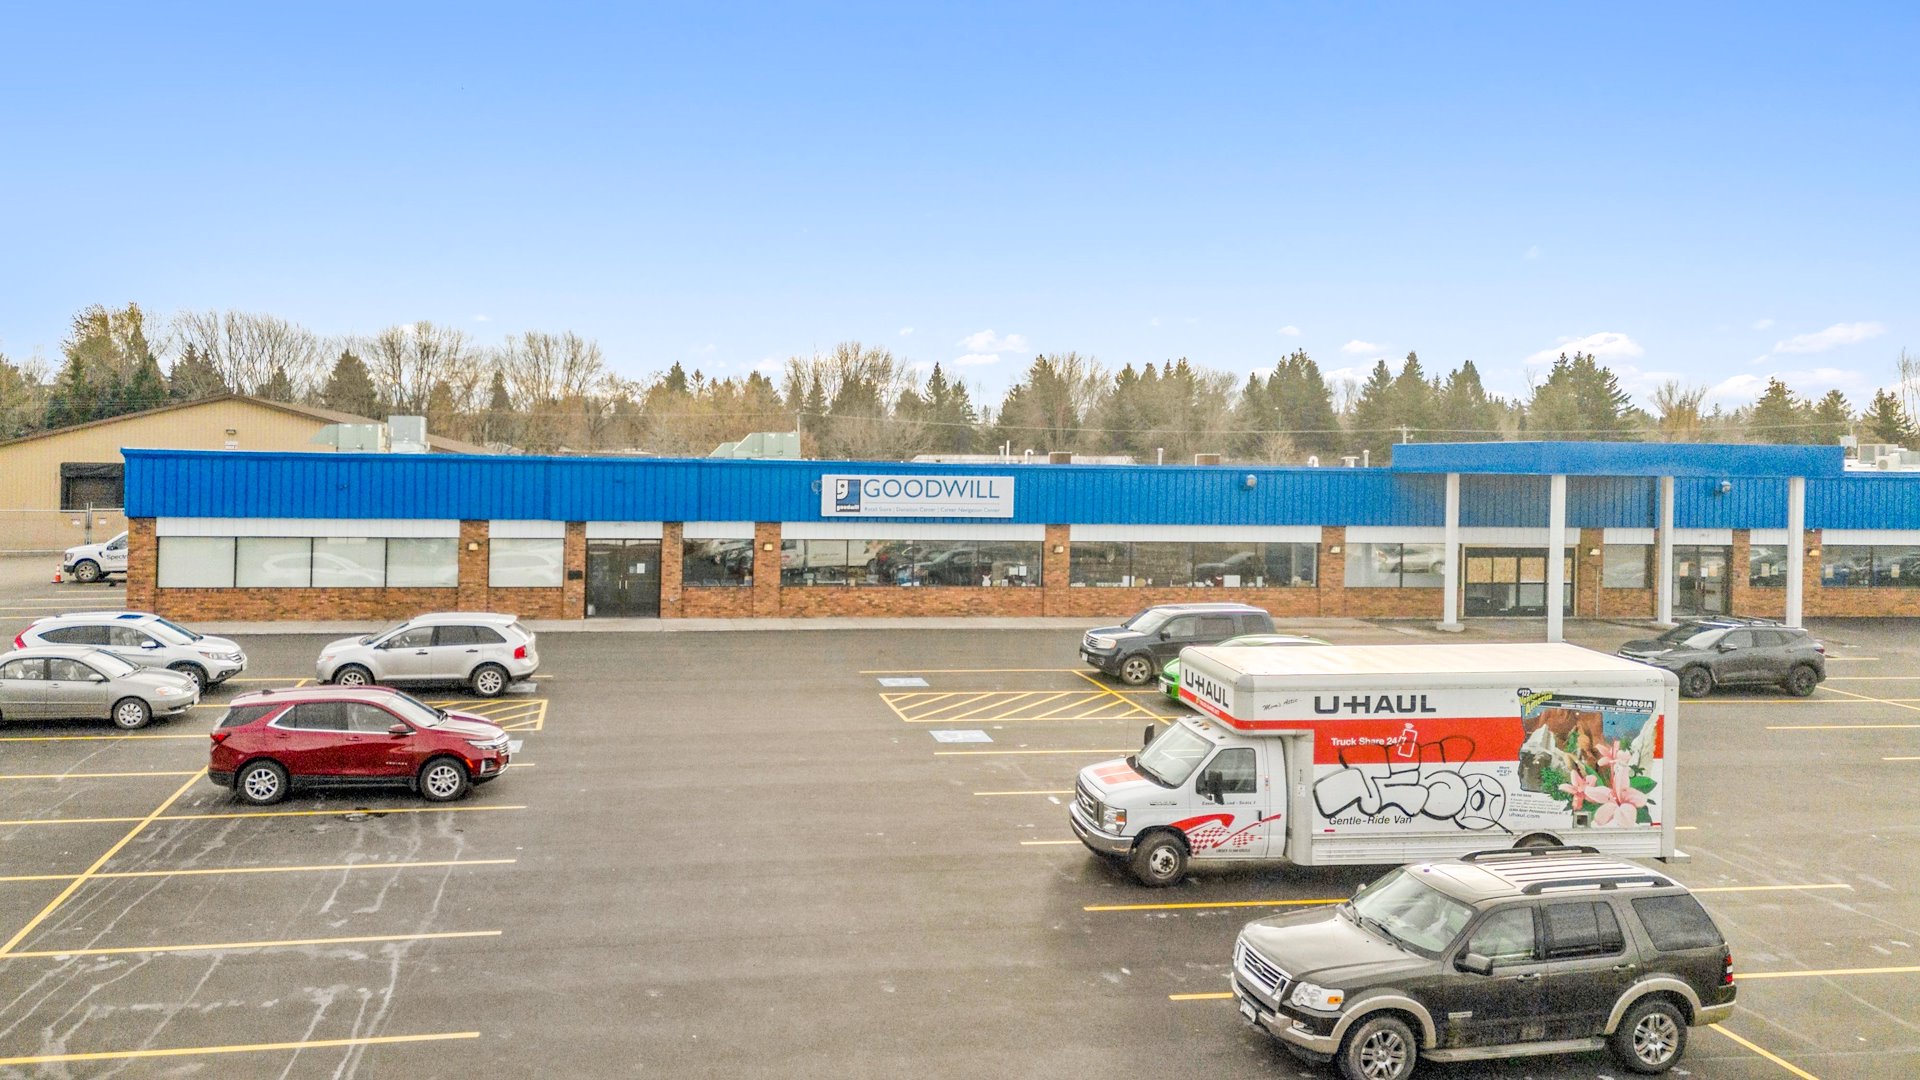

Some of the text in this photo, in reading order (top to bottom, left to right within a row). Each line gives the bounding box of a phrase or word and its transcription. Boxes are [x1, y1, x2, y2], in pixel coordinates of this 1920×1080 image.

[864, 478, 1000, 499] GOODWILL
[1314, 695, 1437, 714] U-HAUL
[1616, 699, 1653, 709] GEORGIA
[1331, 735, 1407, 747] Truck Share 24/7
[1329, 815, 1412, 825] Gentle-Ride Van
